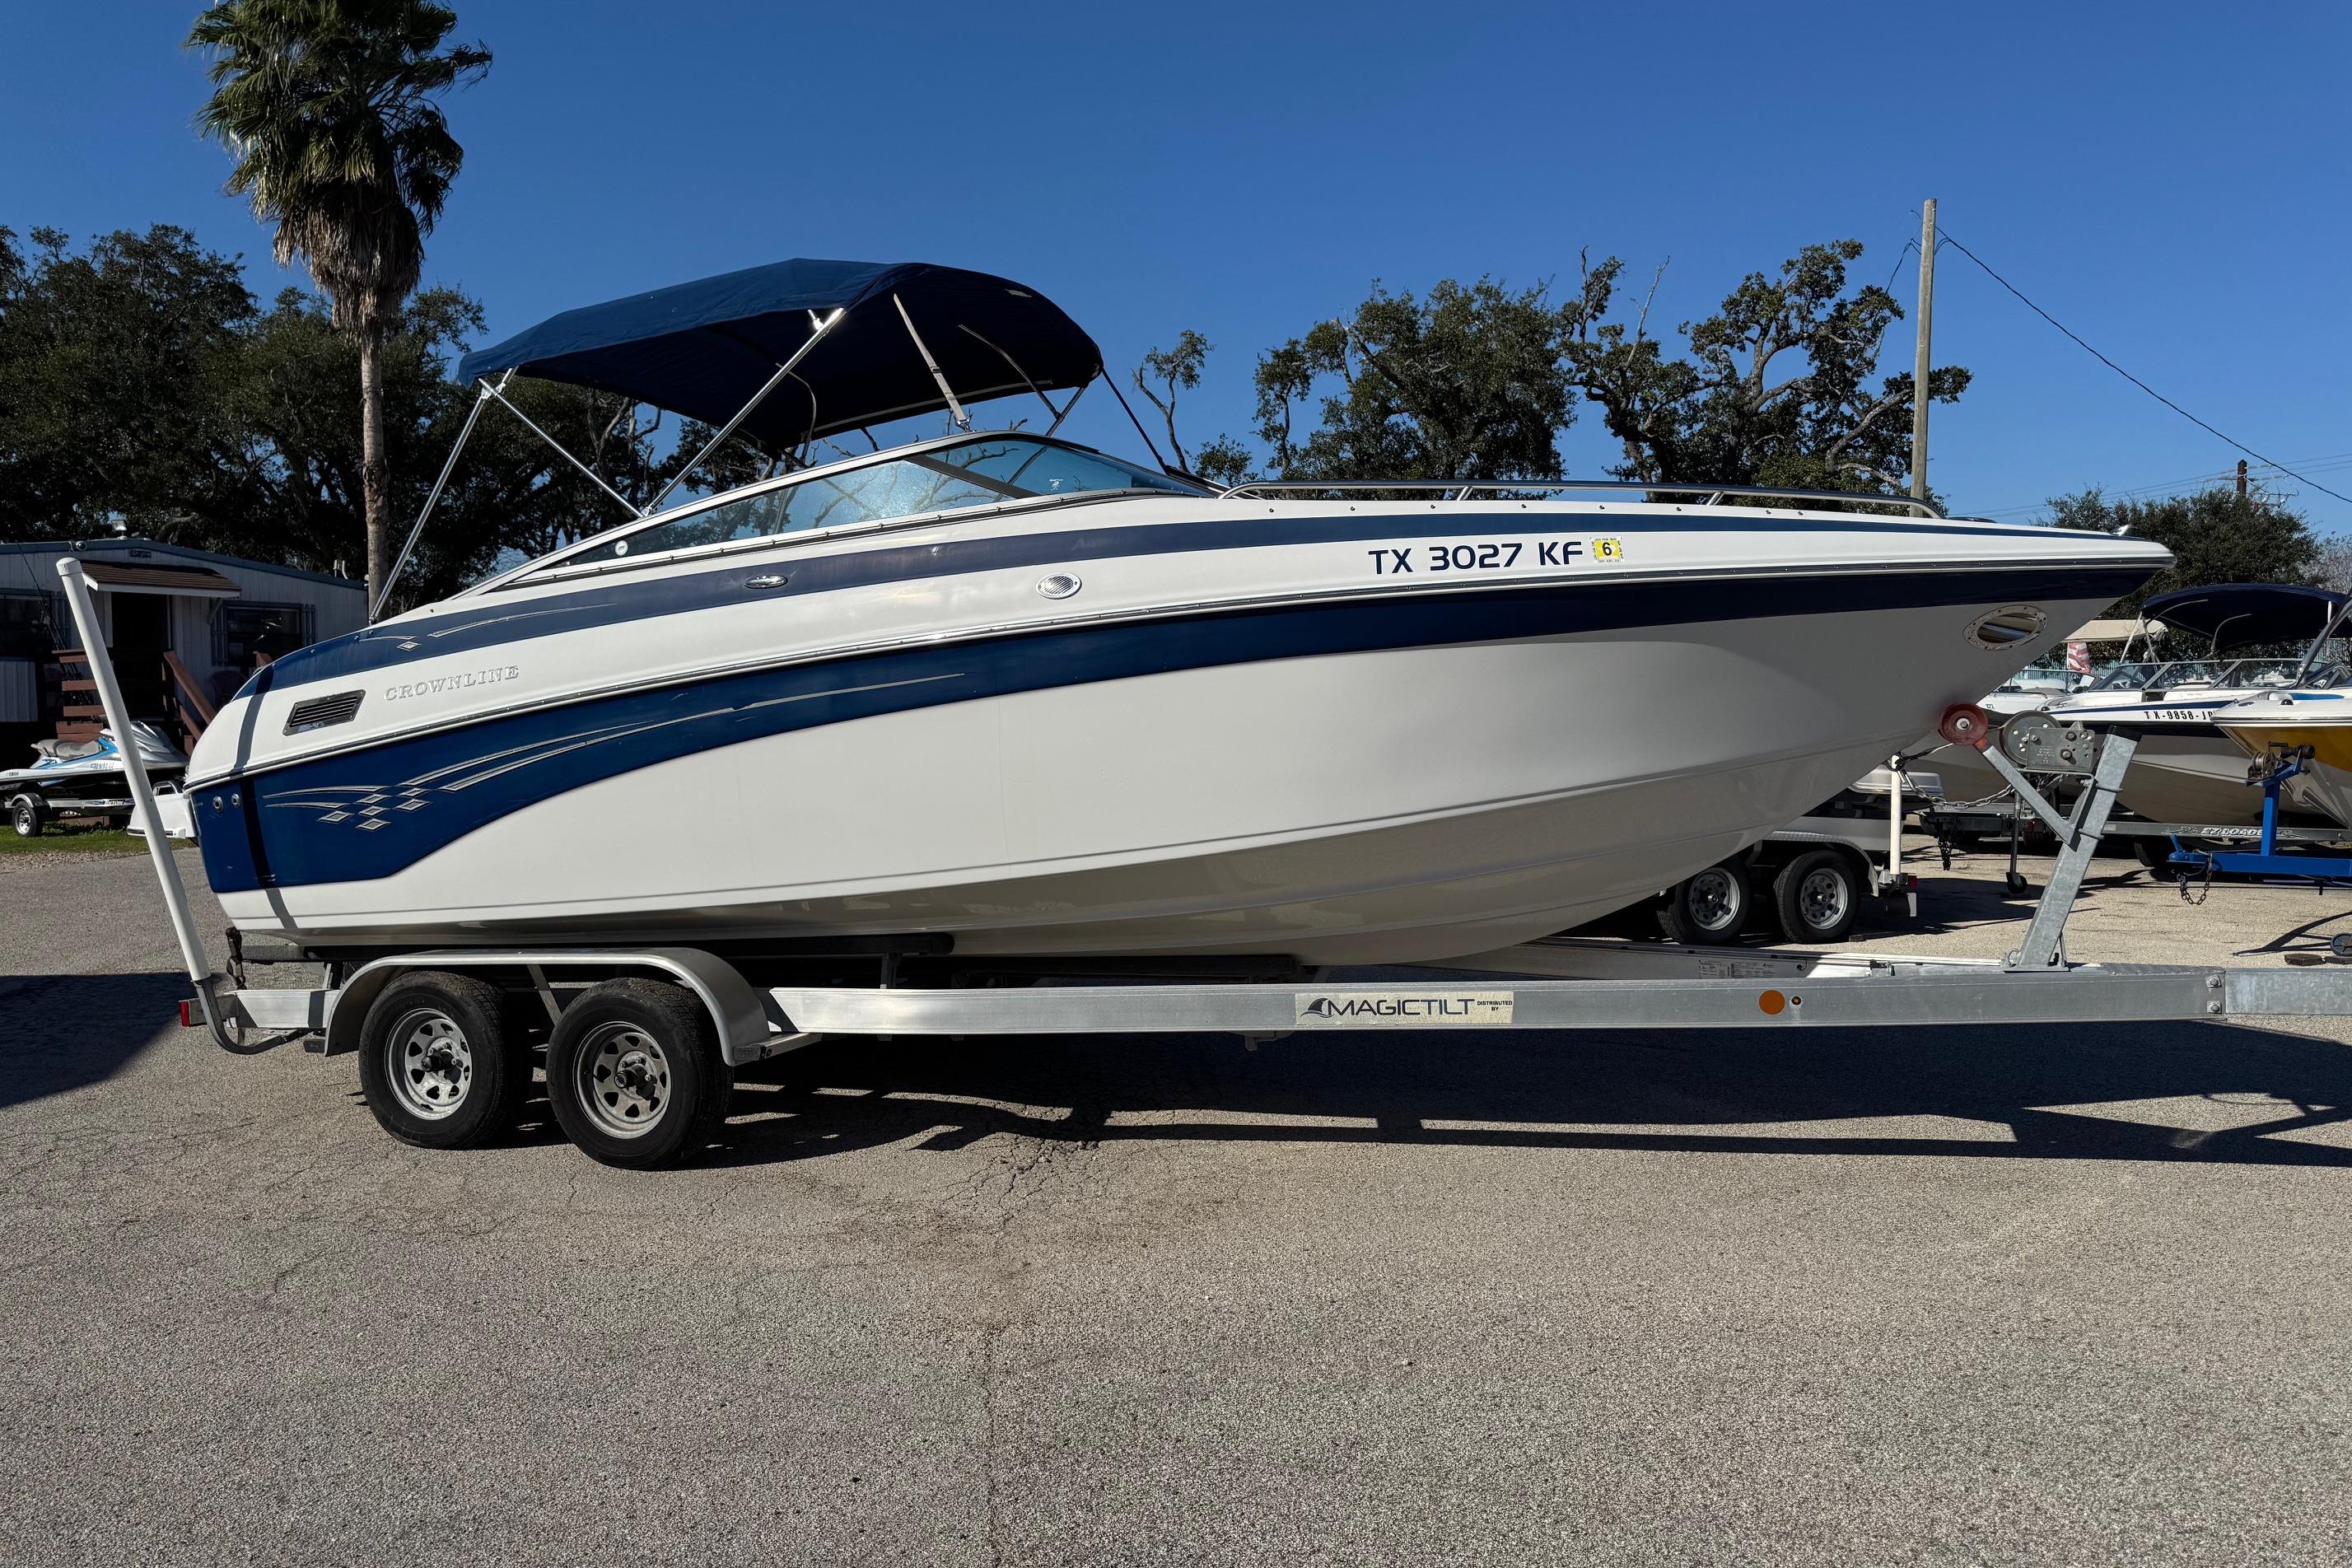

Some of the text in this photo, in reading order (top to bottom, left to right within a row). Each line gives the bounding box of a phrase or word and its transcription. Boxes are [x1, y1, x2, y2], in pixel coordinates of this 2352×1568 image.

[1368, 548, 1413, 574] TX
[1429, 543, 1522, 572] 3027
[1538, 541, 1583, 566] KF
[1602, 542, 1612, 556] 6
[384, 665, 519, 700] CROWNLINE
[1328, 999, 1475, 1015] MAGICTILT
